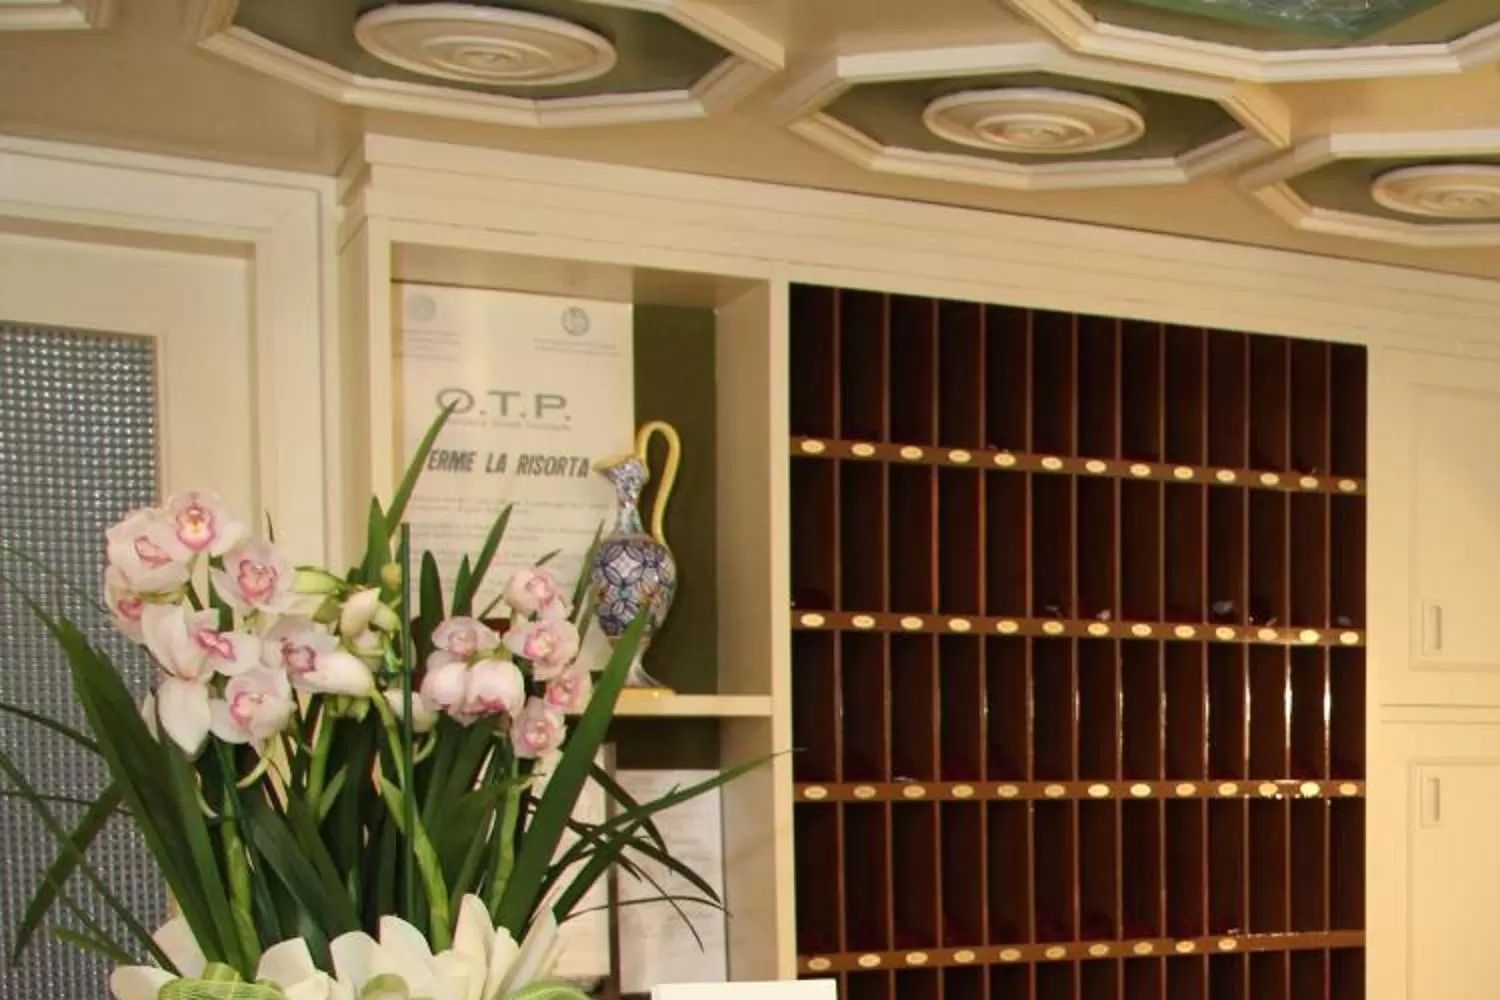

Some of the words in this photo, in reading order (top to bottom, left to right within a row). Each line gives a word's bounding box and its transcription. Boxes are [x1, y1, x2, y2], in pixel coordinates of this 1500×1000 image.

[427, 447, 478, 473] ERME
[485, 450, 508, 474] LA
[516, 453, 592, 480] RISORTA
